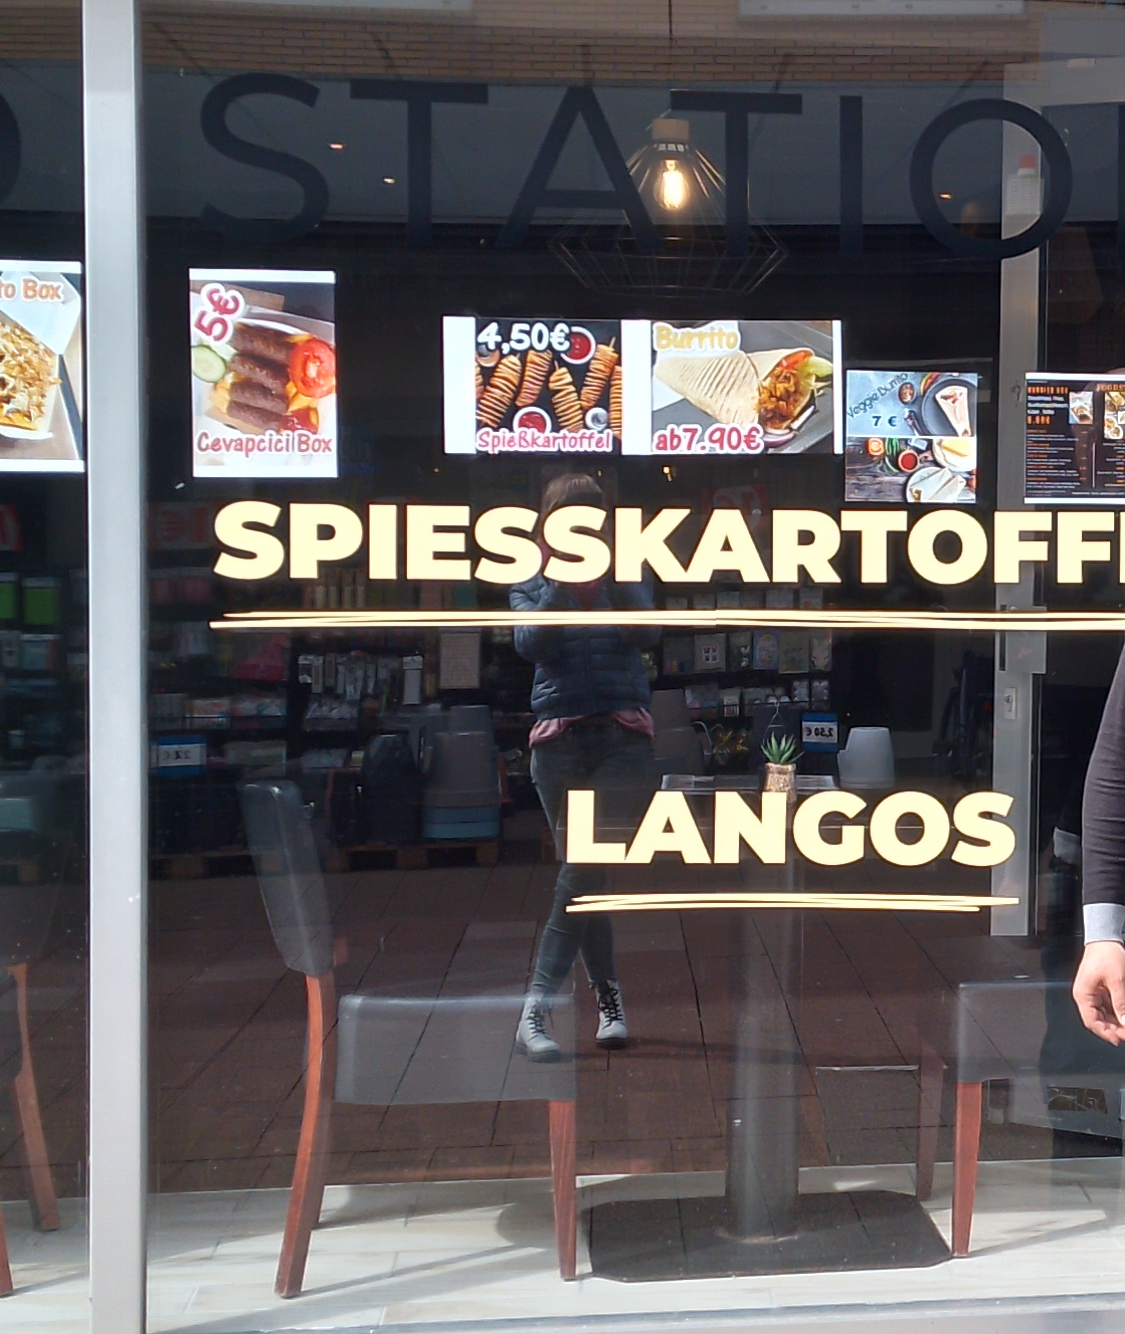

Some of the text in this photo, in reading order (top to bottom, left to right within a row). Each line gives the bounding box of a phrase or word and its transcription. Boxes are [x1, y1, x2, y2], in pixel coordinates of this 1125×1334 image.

[22, 278, 62, 300] Box
[194, 288, 241, 342] 5€
[477, 322, 571, 354] 4,50€
[656, 325, 739, 349] Burrito
[872, 415, 898, 427] 7 €
[197, 431, 333, 457] Cevapcici Box
[478, 430, 612, 451] Spießkartoffel
[565, 789, 1017, 867] LANGOS
